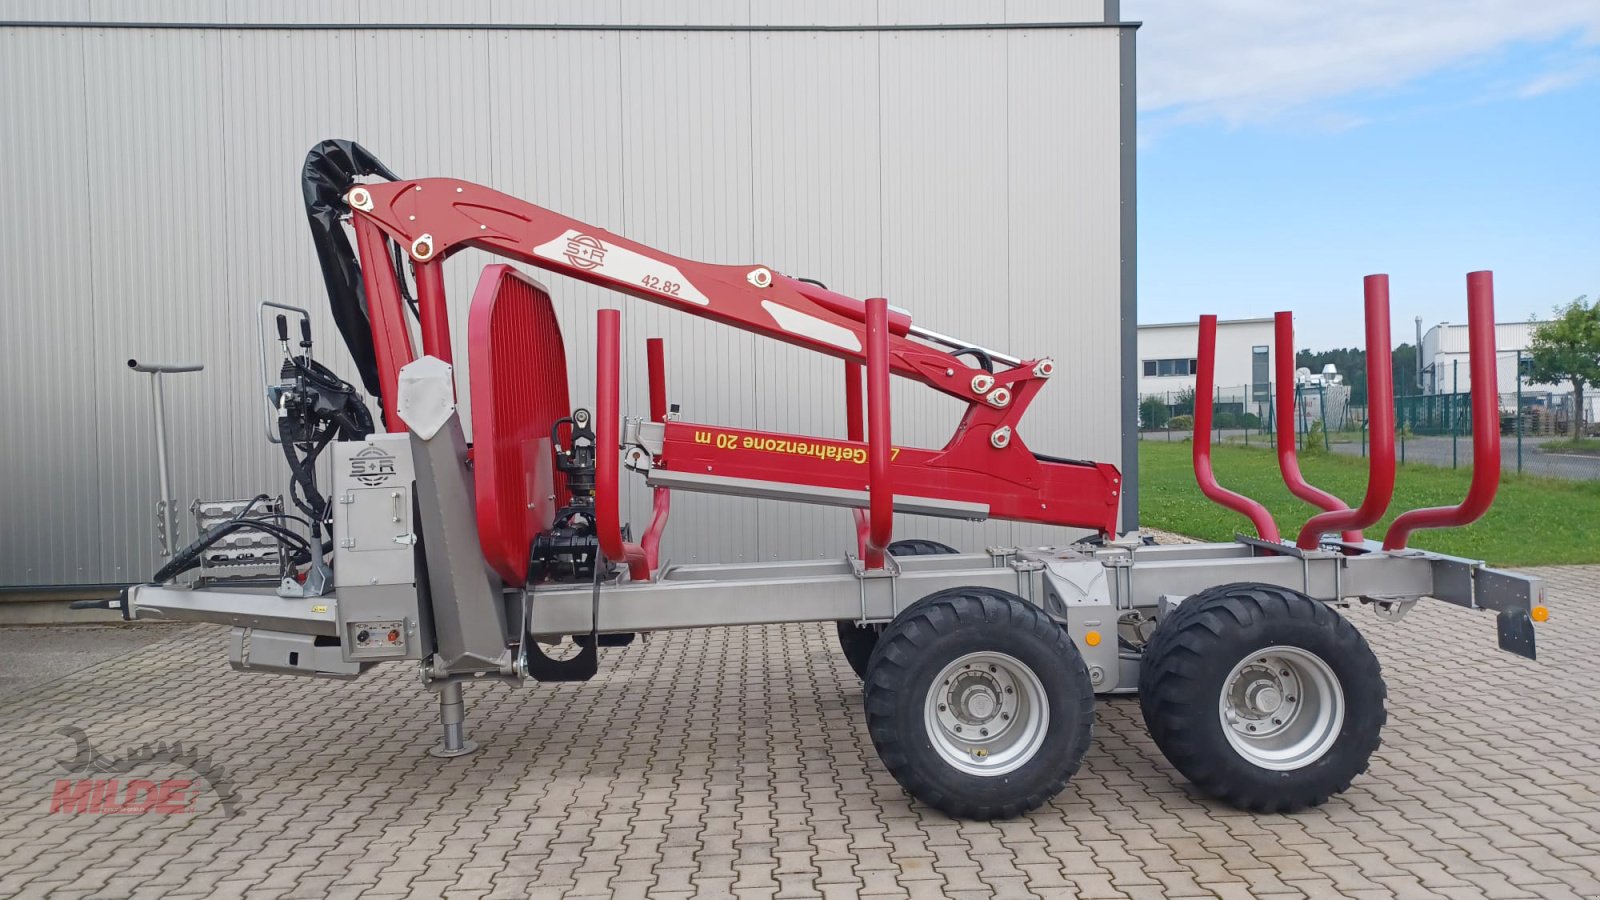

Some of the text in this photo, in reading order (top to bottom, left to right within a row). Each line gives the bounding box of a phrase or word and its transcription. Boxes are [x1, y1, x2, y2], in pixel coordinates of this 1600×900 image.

[641, 274, 681, 296] 42.82
[695, 431, 867, 464] Gefahrenzone 20 m
